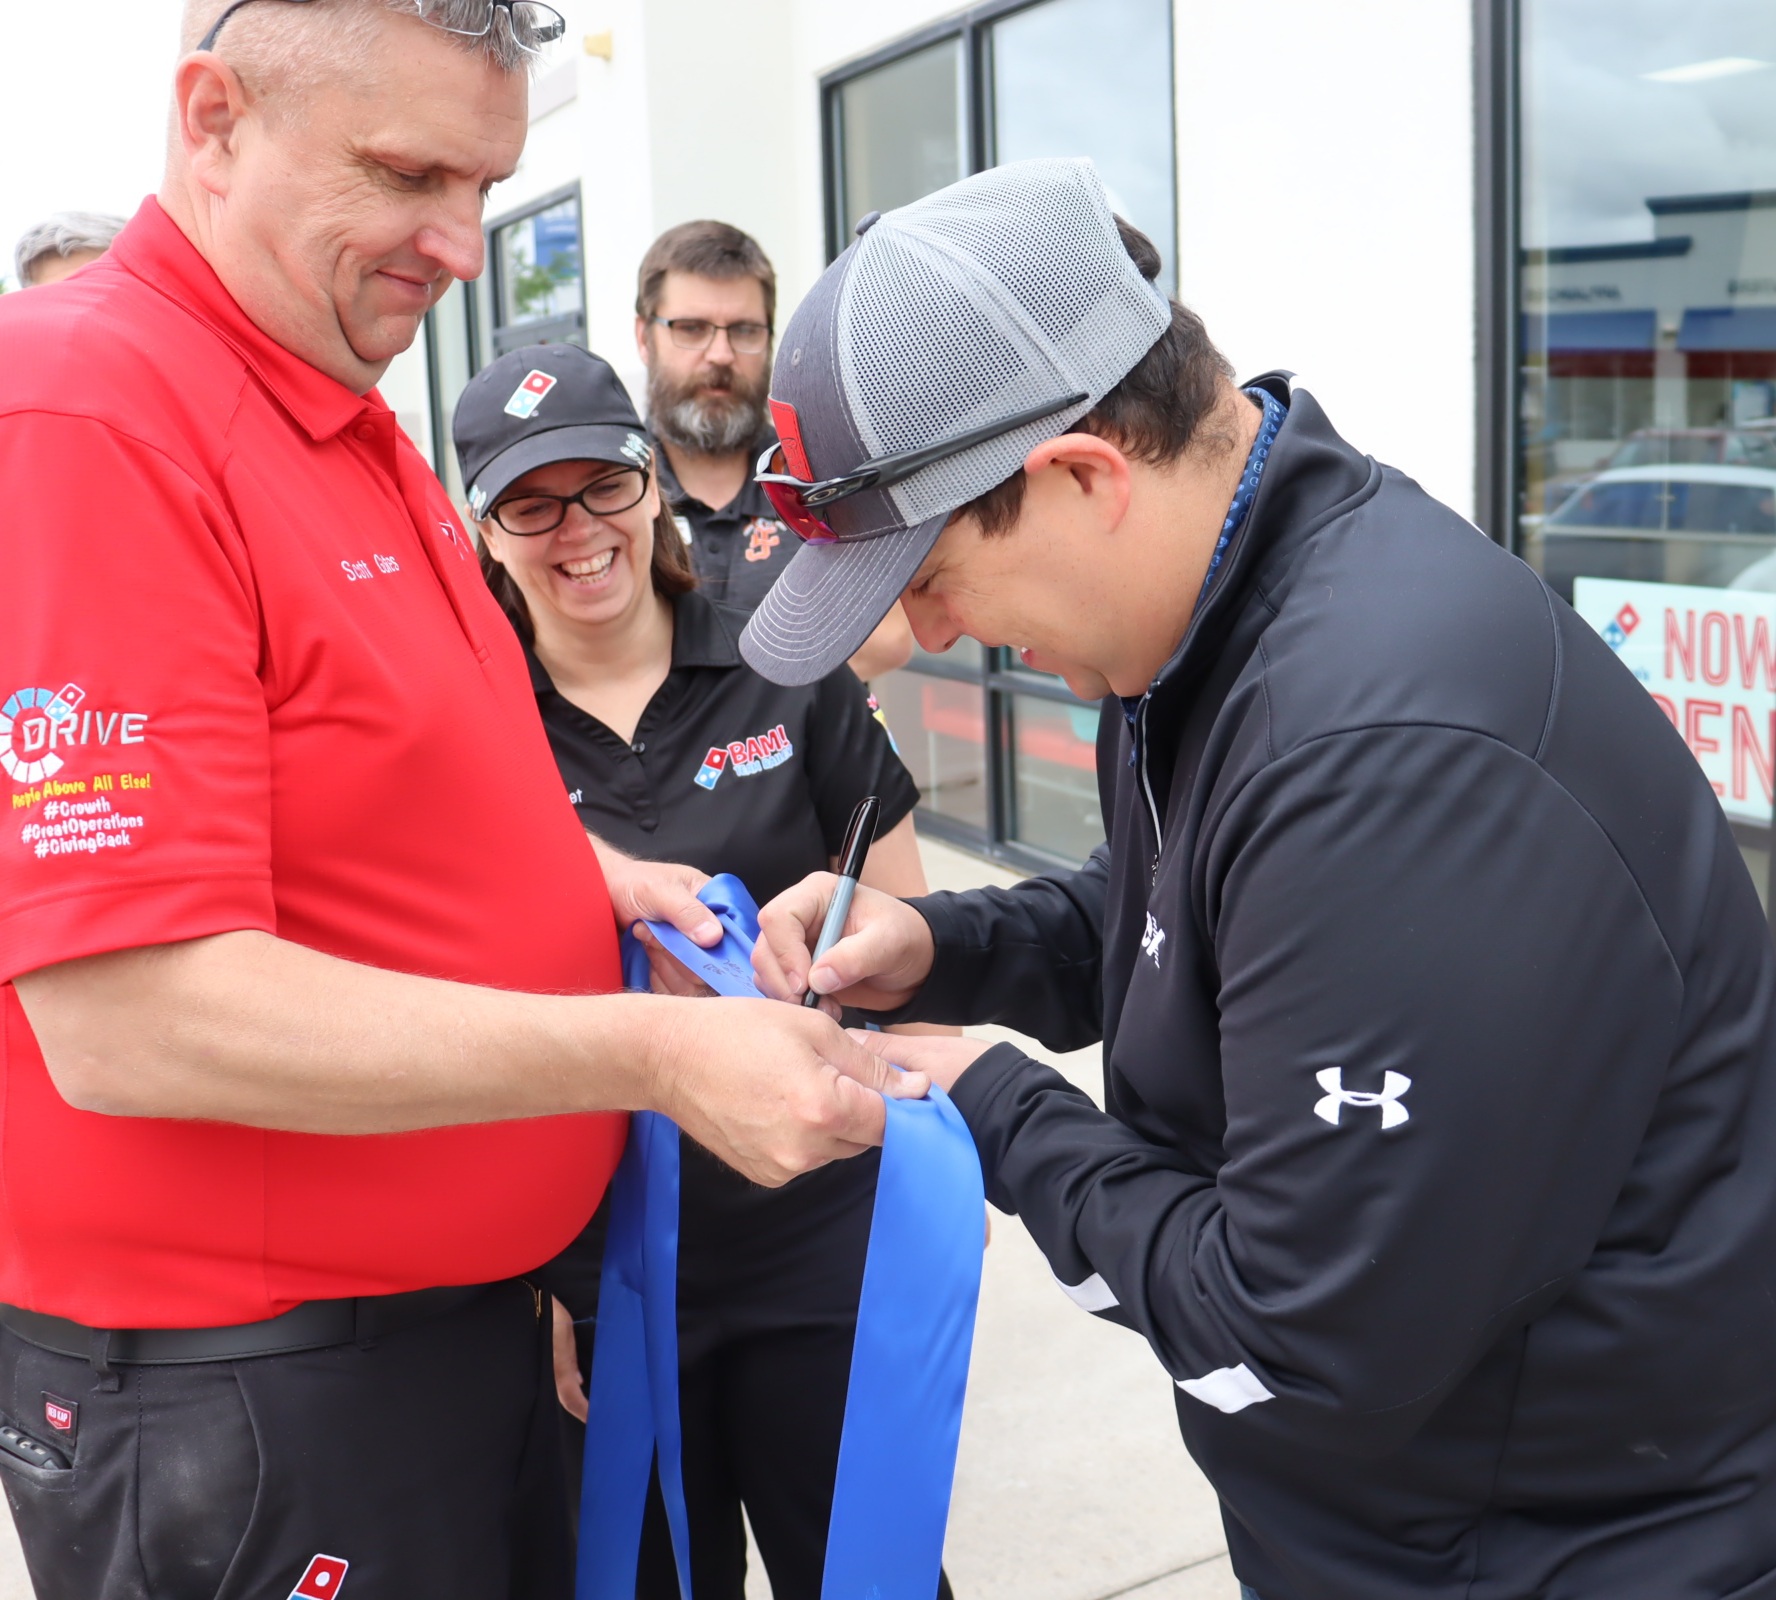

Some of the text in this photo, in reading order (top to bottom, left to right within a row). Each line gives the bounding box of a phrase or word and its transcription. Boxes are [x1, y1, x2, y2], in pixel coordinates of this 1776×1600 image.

[340, 559, 374, 582] Scott
[1665, 607, 1776, 692] NOW
[22, 710, 149, 753] DRIVE
[727, 724, 791, 766] BAM!
[42, 779, 86, 799] Above
[93, 774, 114, 792] All
[120, 772, 151, 790] Else!
[34, 829, 132, 859] #GivingBack
